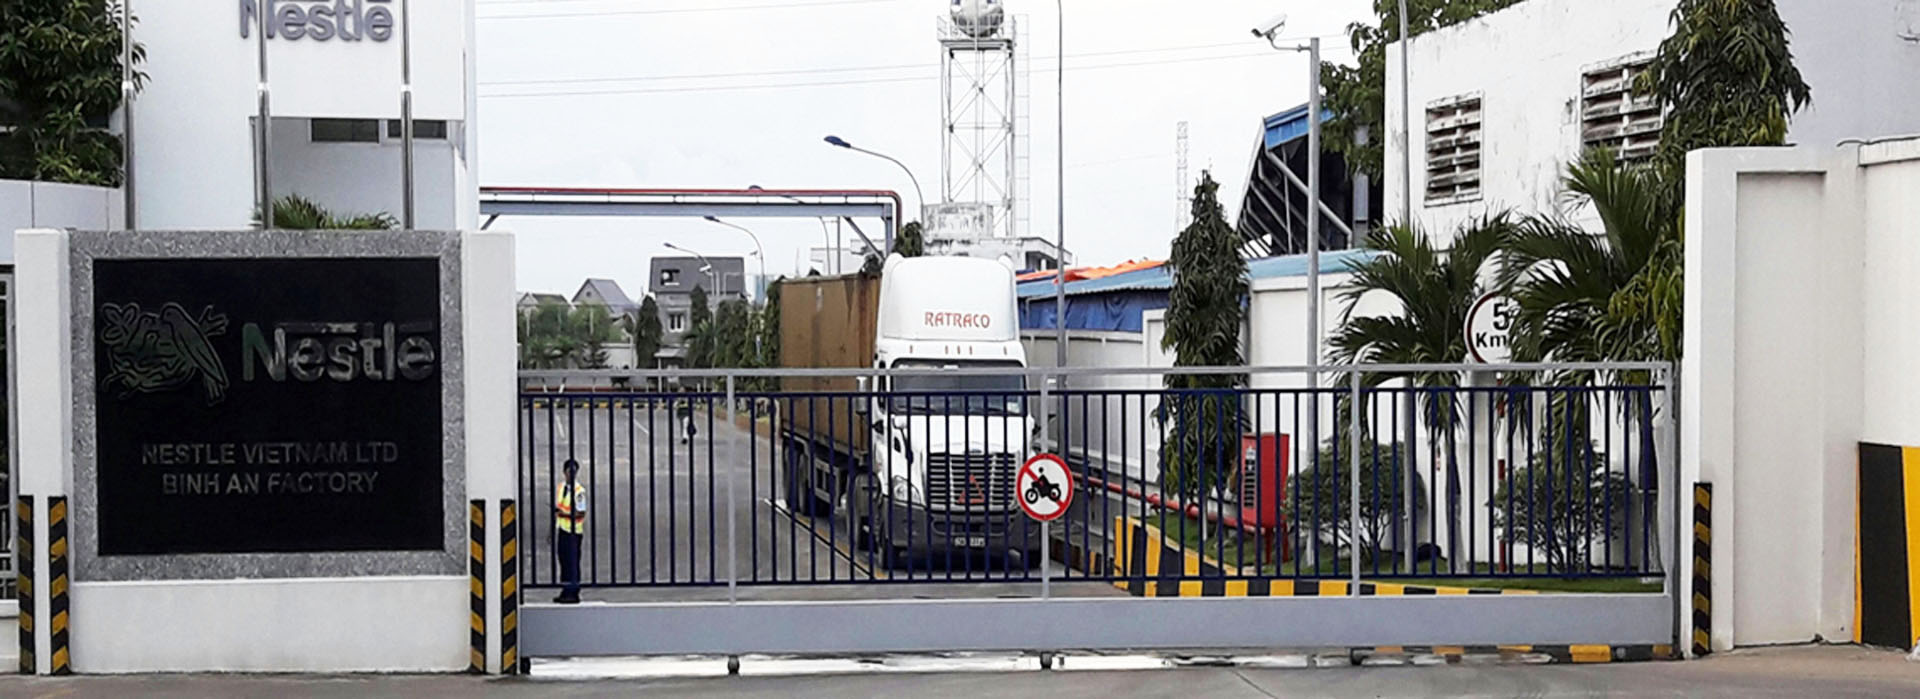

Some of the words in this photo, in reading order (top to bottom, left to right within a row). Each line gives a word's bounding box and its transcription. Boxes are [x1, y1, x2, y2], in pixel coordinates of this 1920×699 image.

[924, 311, 991, 329] RATRACO
[1492, 303, 1510, 331] 5
[1475, 332, 1507, 349] Km
[142, 443, 236, 465] NESTLE
[243, 441, 349, 465] VIETNAM
[356, 441, 399, 463] LTD
[162, 473, 220, 495] BINH
[225, 472, 260, 495] AN
[267, 471, 379, 494] FACTORY
